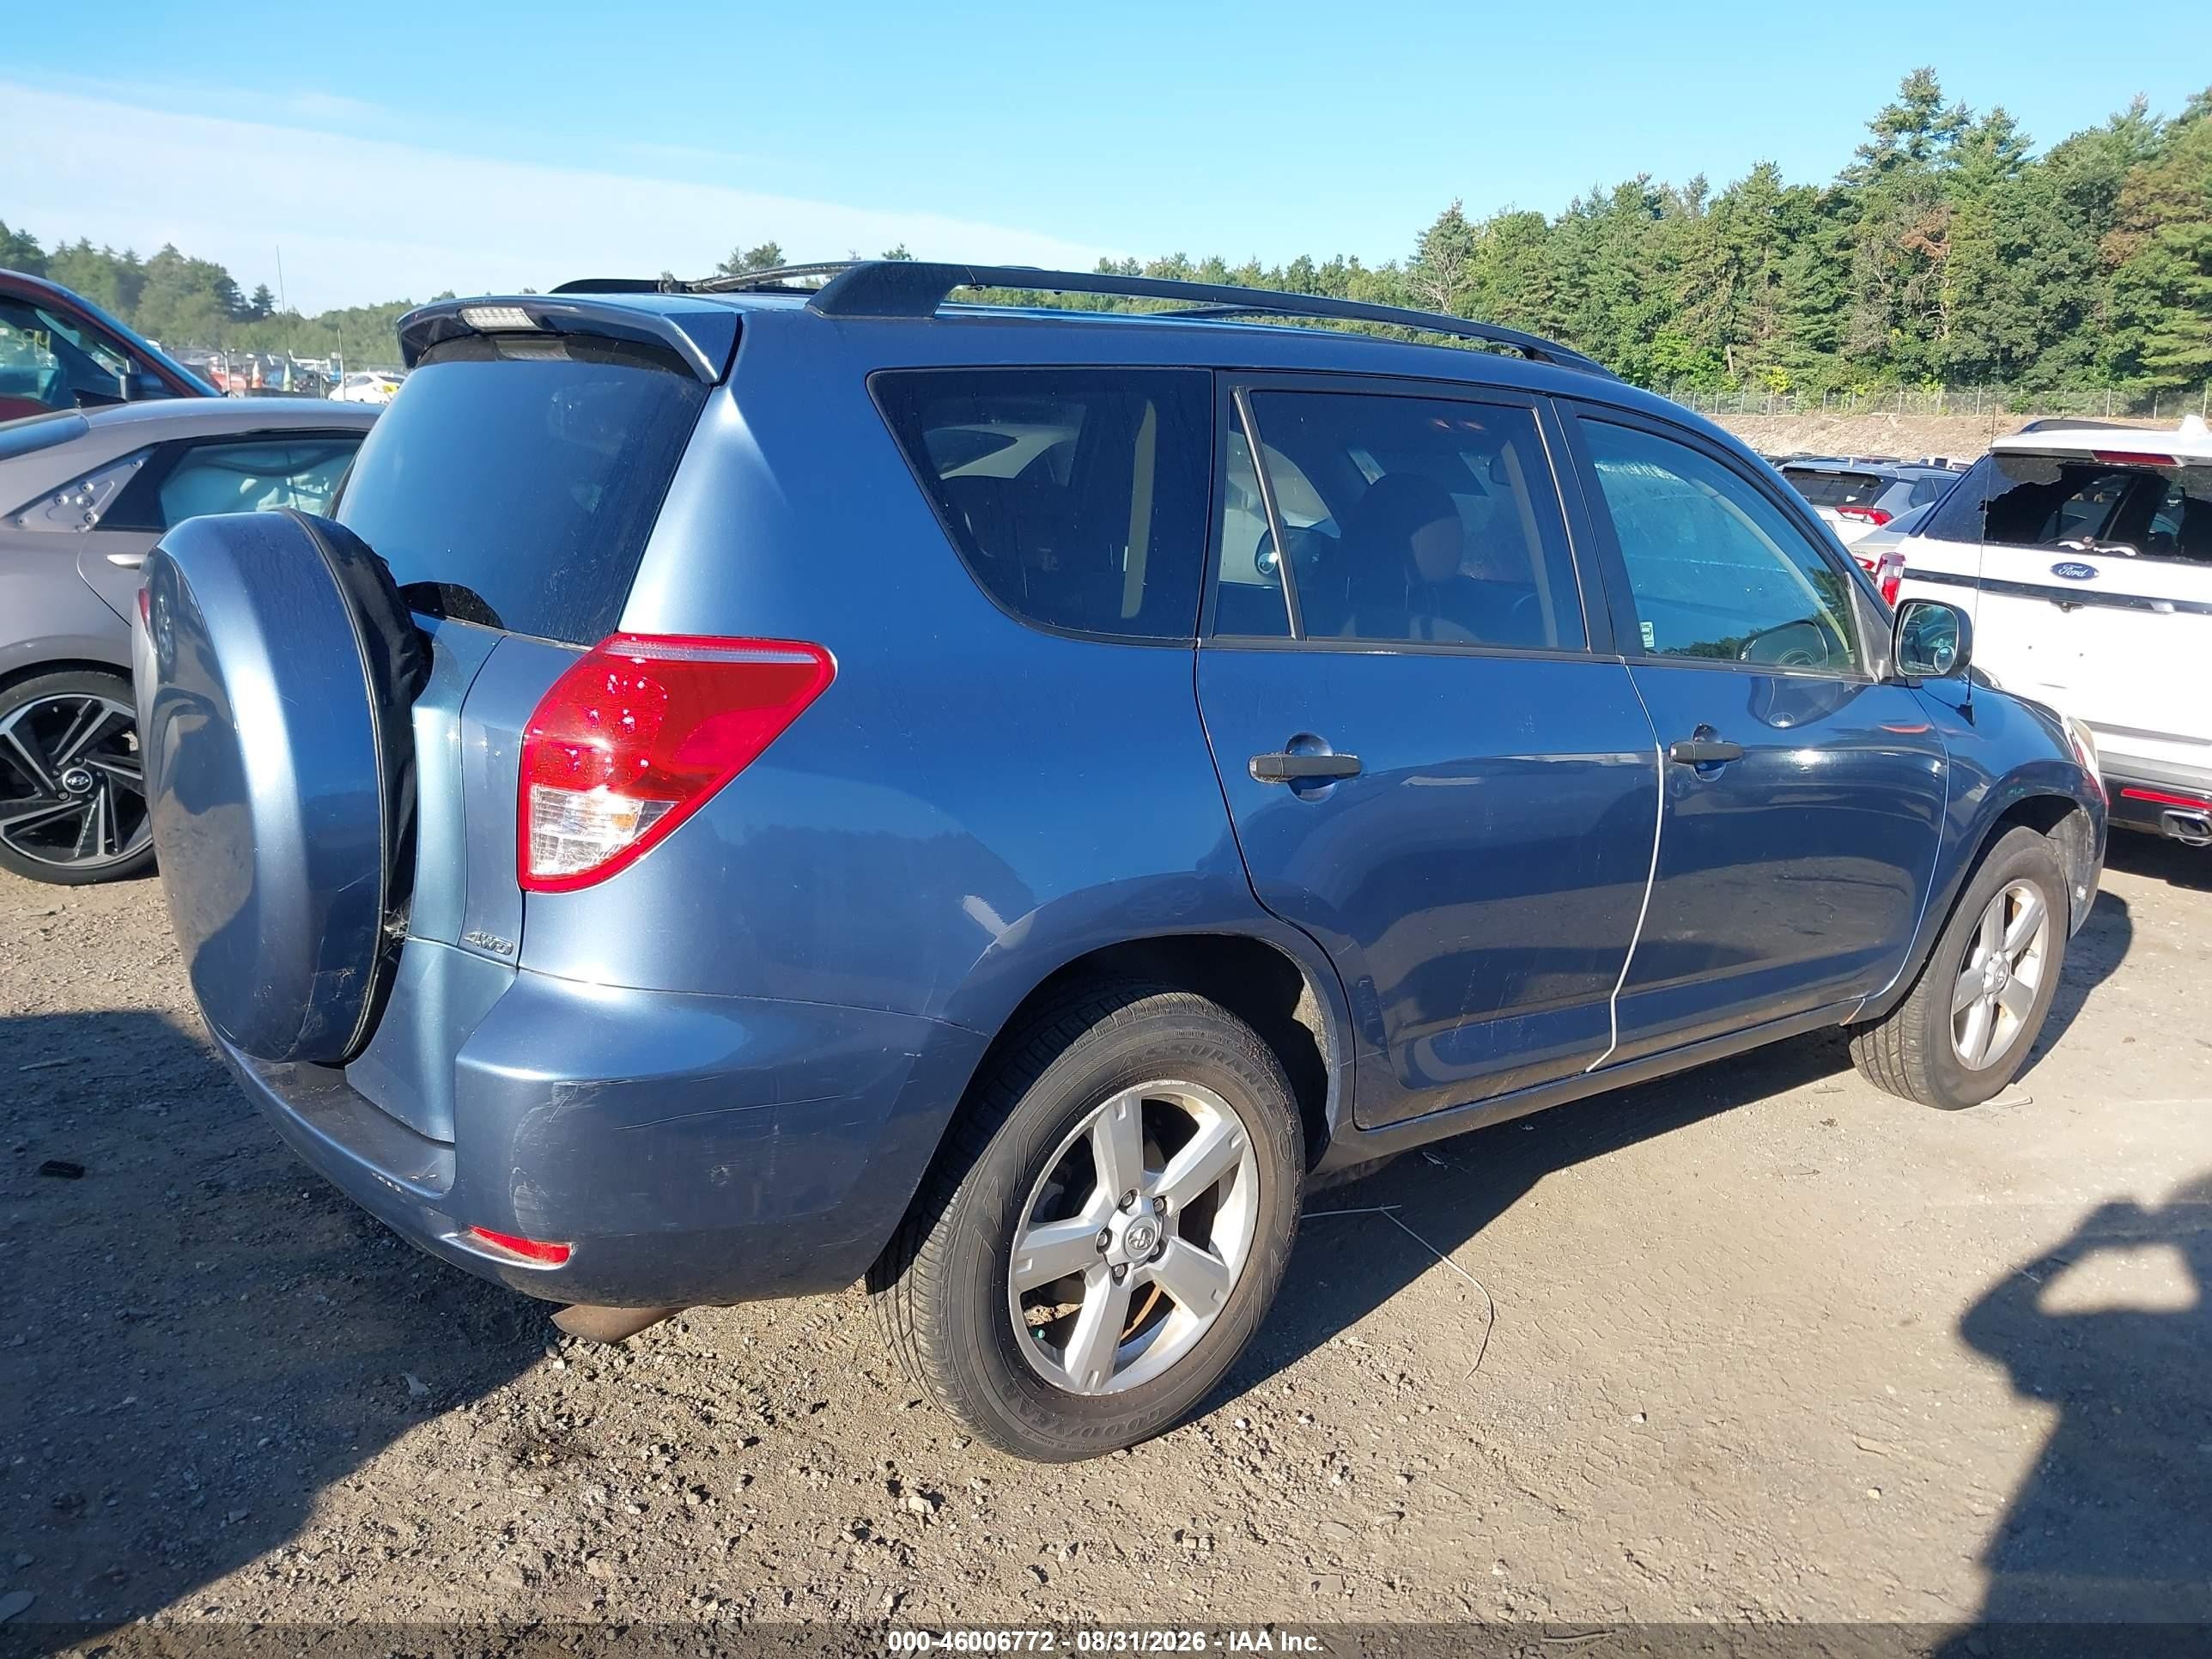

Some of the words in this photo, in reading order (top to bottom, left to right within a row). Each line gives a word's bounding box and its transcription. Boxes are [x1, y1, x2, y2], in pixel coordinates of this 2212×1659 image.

[2058, 564, 2088, 577] Ford
[1118, 1042, 1283, 1122] ASSURANCE
[1000, 1379, 1164, 1439] GOODYEAR
